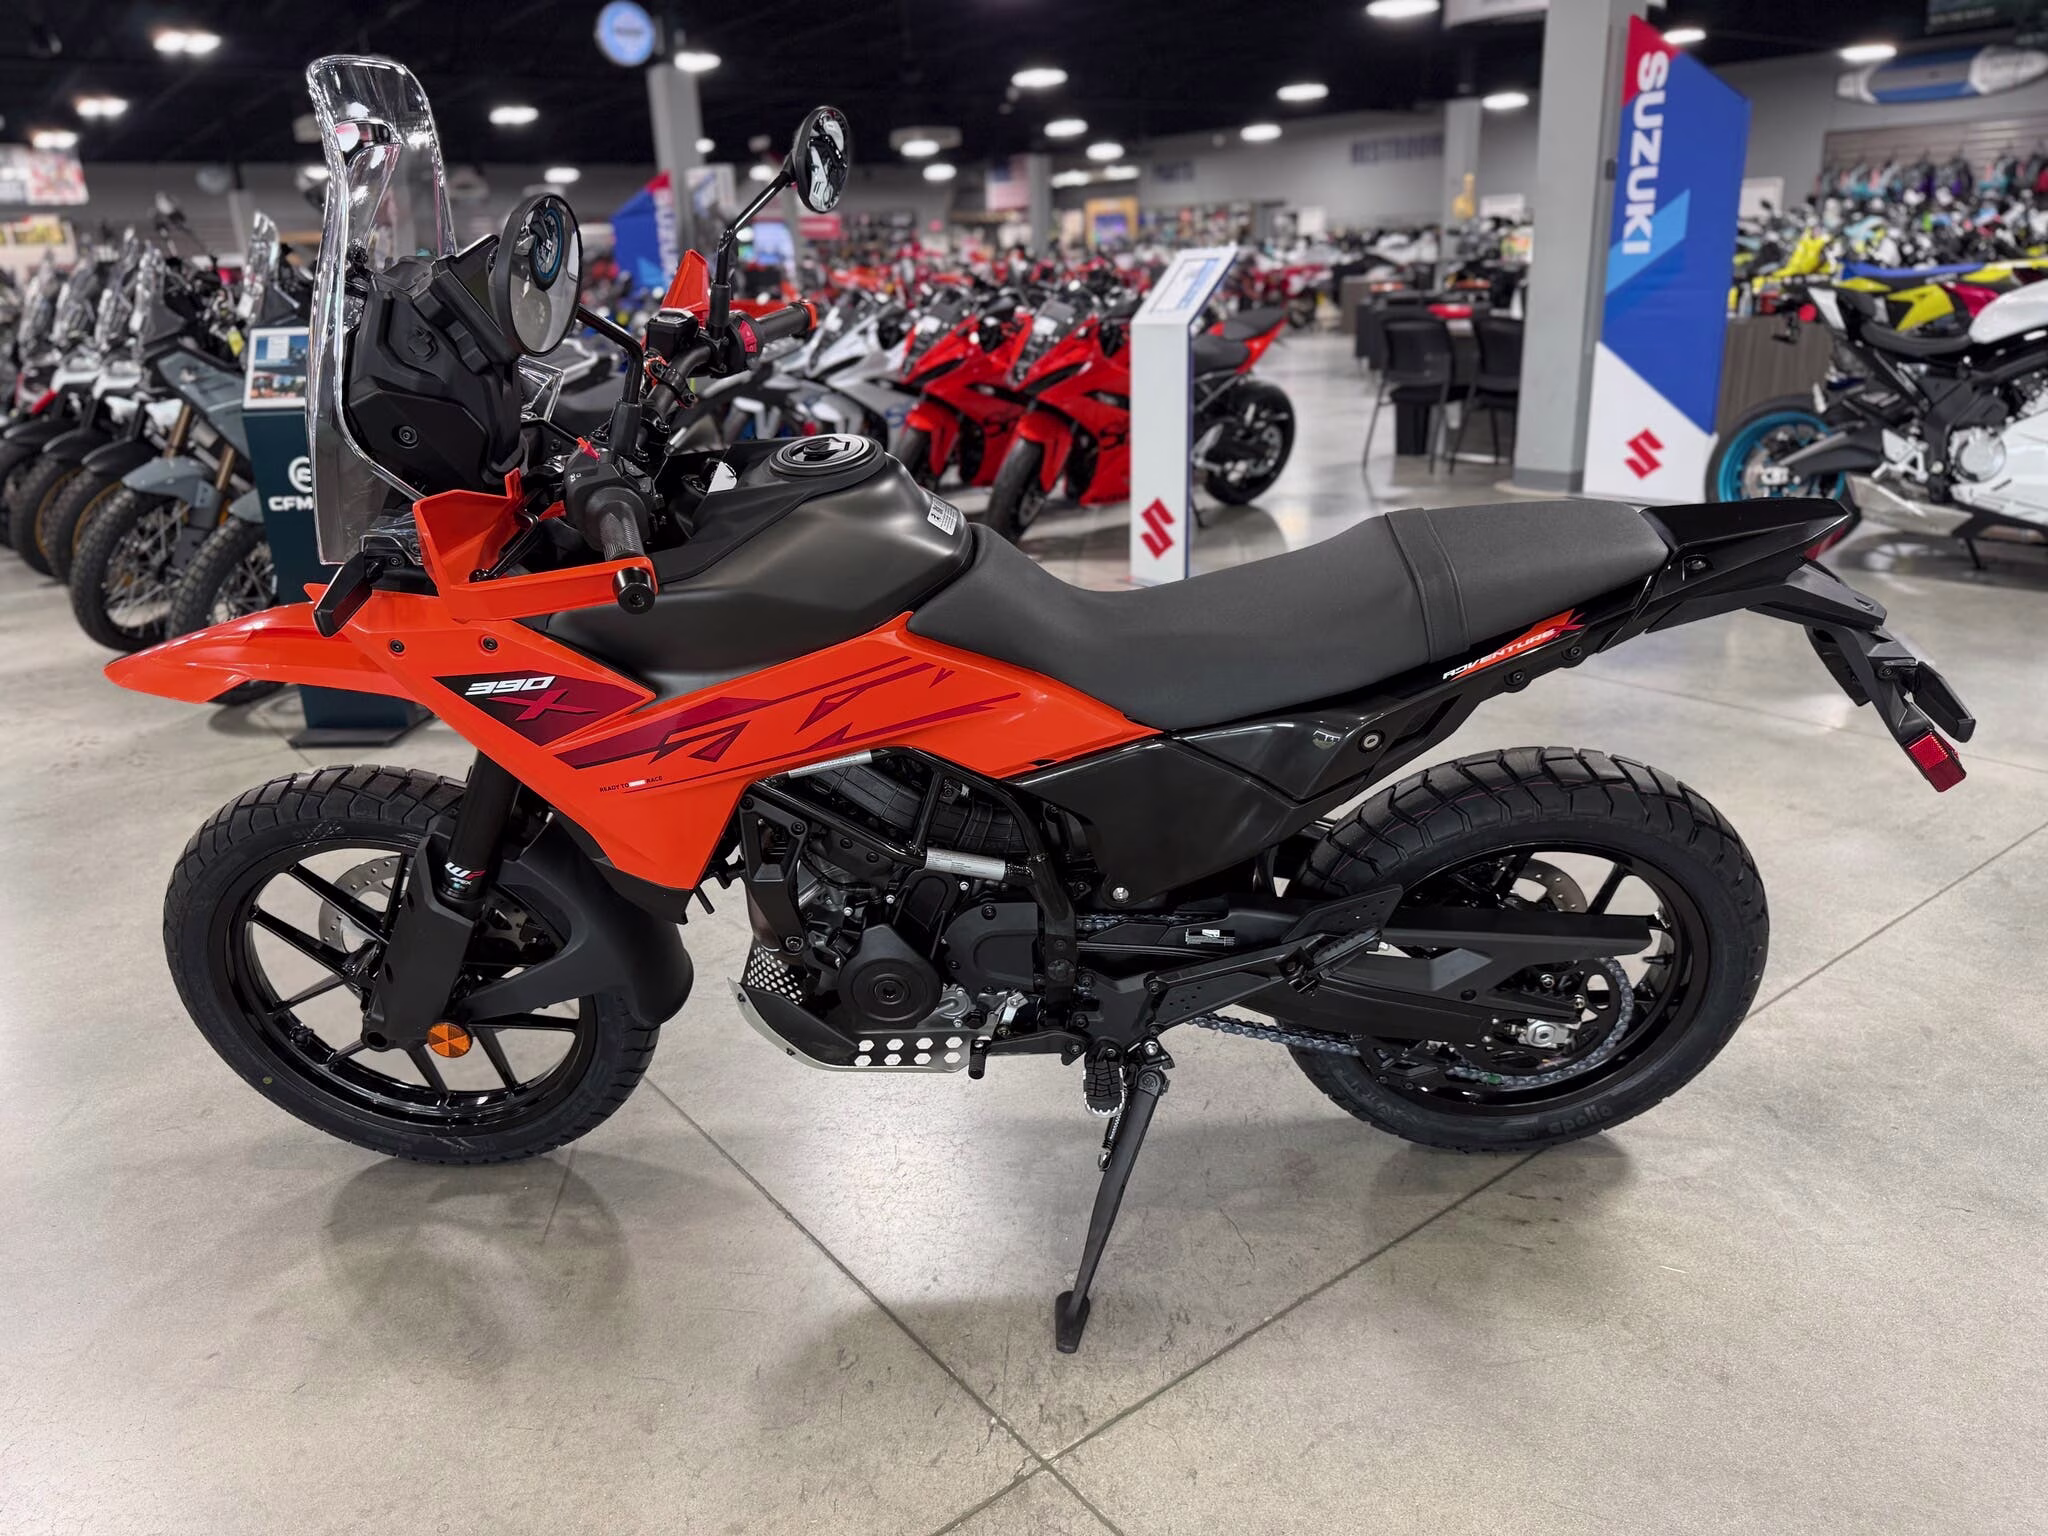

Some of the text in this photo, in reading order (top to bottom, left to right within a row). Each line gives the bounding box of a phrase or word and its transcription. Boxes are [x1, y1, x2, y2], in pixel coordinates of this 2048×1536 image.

[1622, 50, 1669, 254] SUZUKI
[268, 496, 314, 511] CFM
[465, 675, 556, 696] 390
[599, 784, 620, 793] READY
[646, 775, 663, 784] RACE
